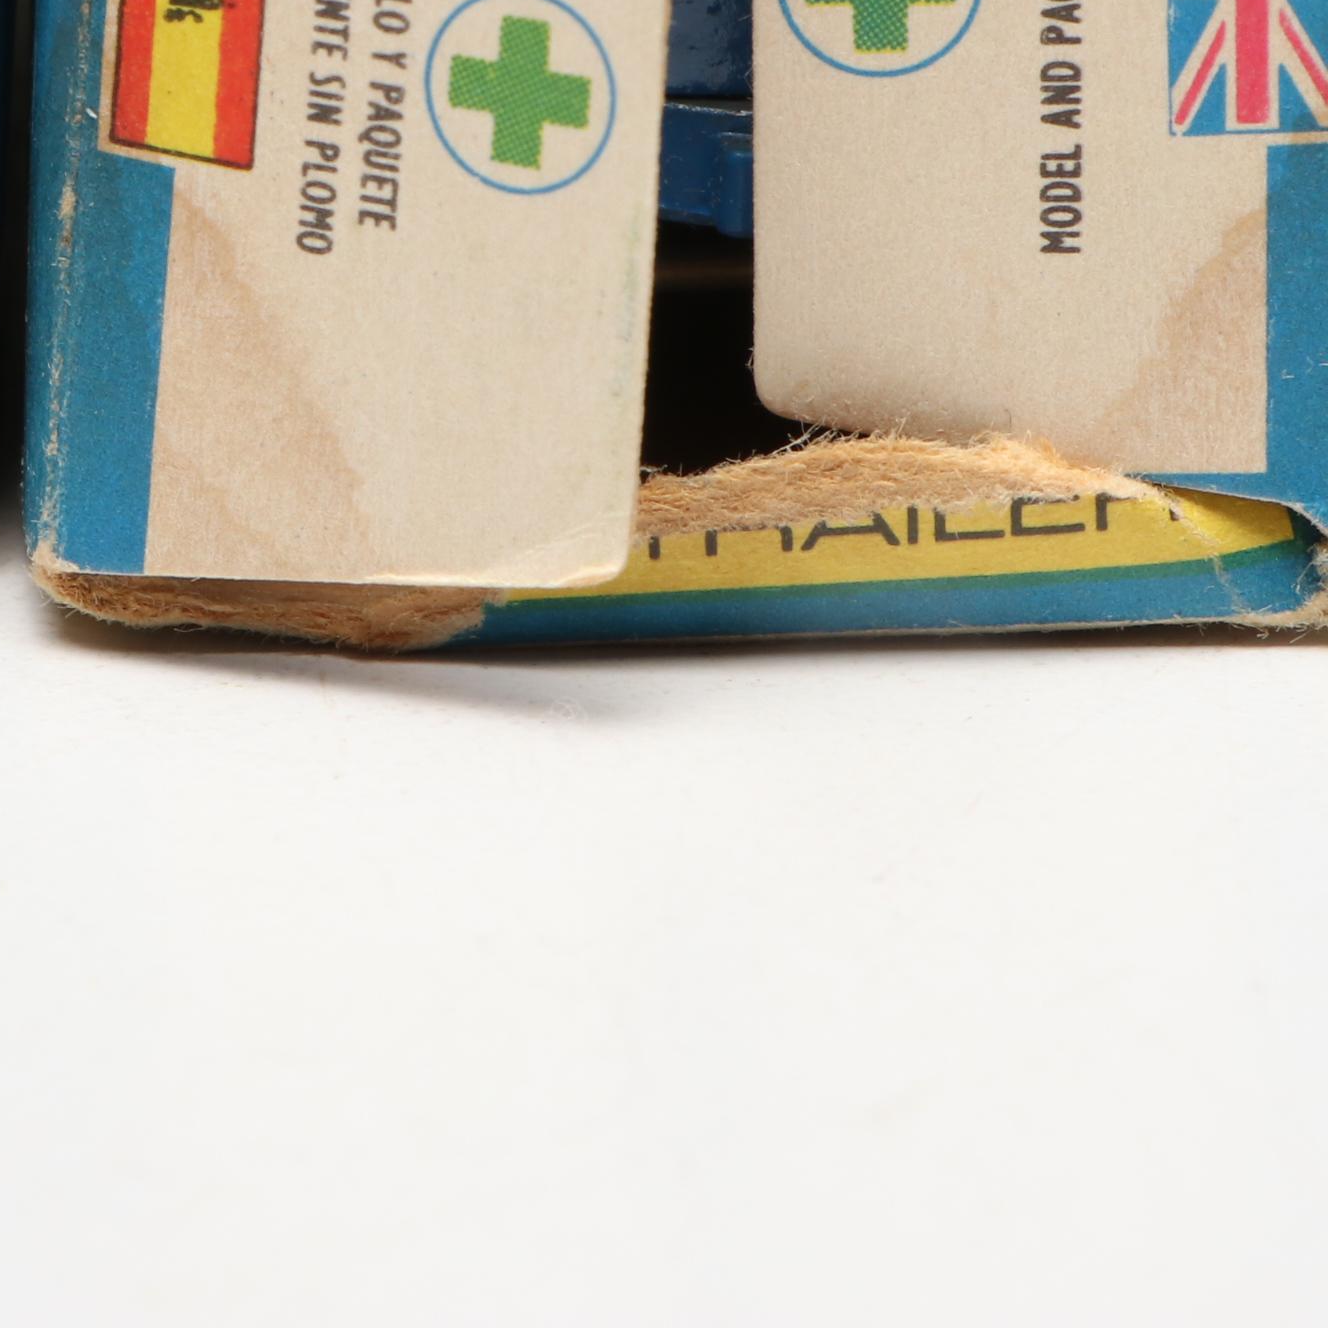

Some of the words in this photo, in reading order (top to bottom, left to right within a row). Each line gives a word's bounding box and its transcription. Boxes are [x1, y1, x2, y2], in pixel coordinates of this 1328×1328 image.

[306, 71, 347, 127] SIN
[371, 51, 408, 70] Y
[1039, 60, 1083, 130] AND
[296, 138, 340, 256] PLOMO
[358, 81, 407, 232] PAQUETE
[1039, 143, 1083, 254] MODEL
